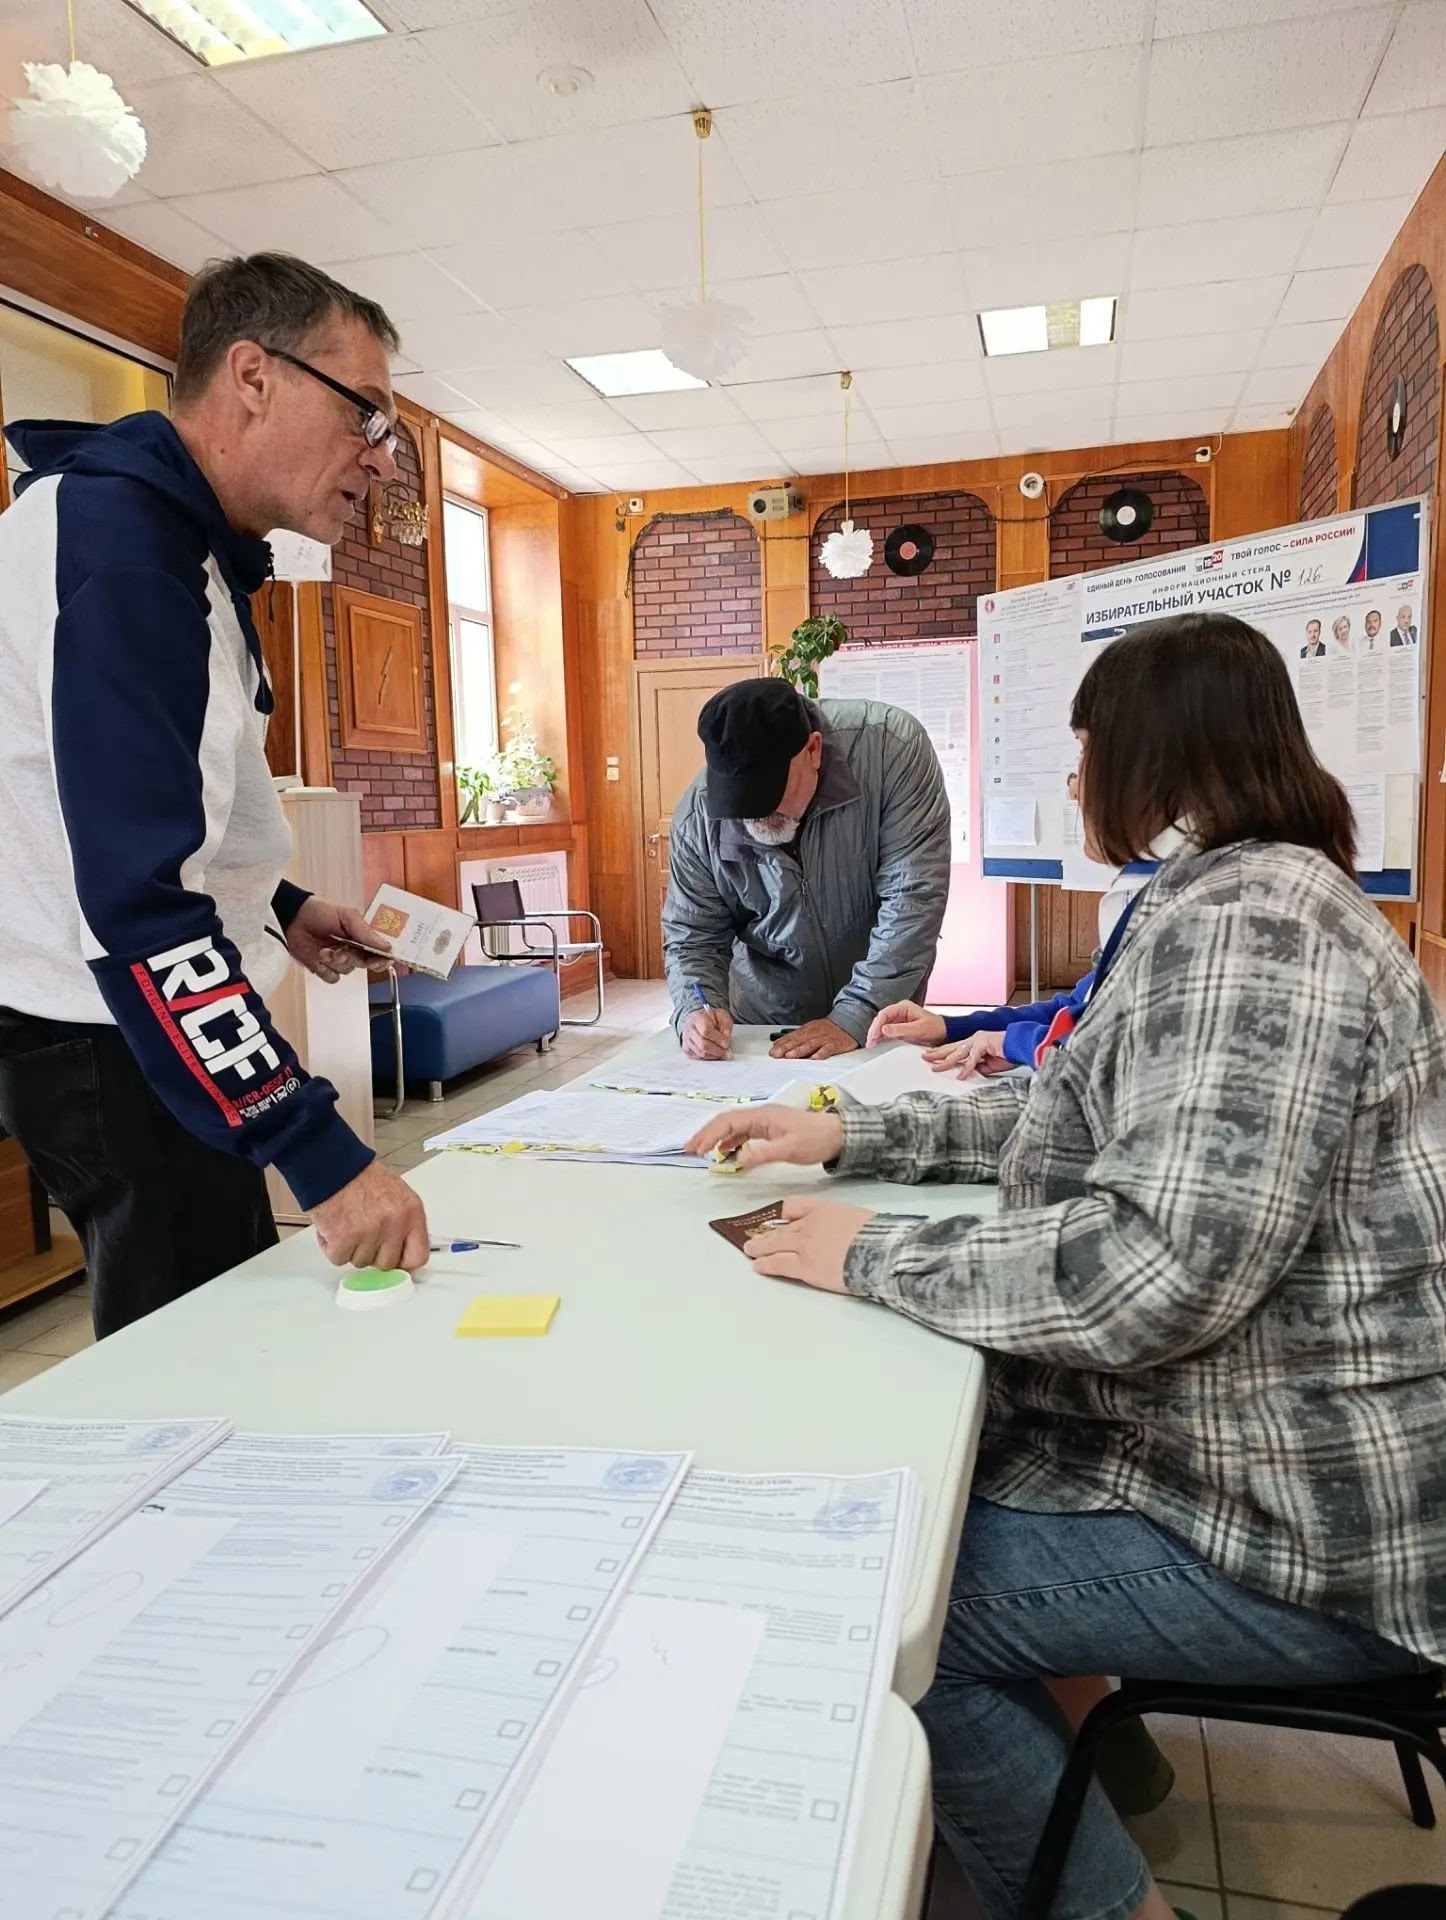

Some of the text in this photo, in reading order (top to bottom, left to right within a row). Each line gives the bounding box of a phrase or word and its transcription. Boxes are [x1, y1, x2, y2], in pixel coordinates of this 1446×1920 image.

[1230, 548, 1252, 561] ТВОЙ
[1253, 543, 1282, 556] ГОЛОС
[1289, 534, 1313, 549] СИЛА
[1315, 527, 1356, 543] РОССИИ!
[1087, 565, 1186, 593] ЕДИНЫЙ ДЕНЬ ГОЛОСОВАНИЯ
[1152, 565, 1271, 595] ИНФОРМАЦИОННЫЙ СТЕНД
[1086, 590, 1194, 625] ИЗБИРАТЕЛЬНЫЙ
[1197, 579, 1264, 605] УЧАСТОК
[1270, 569, 1292, 591] №
[136, 970, 171, 1028] FORGING
